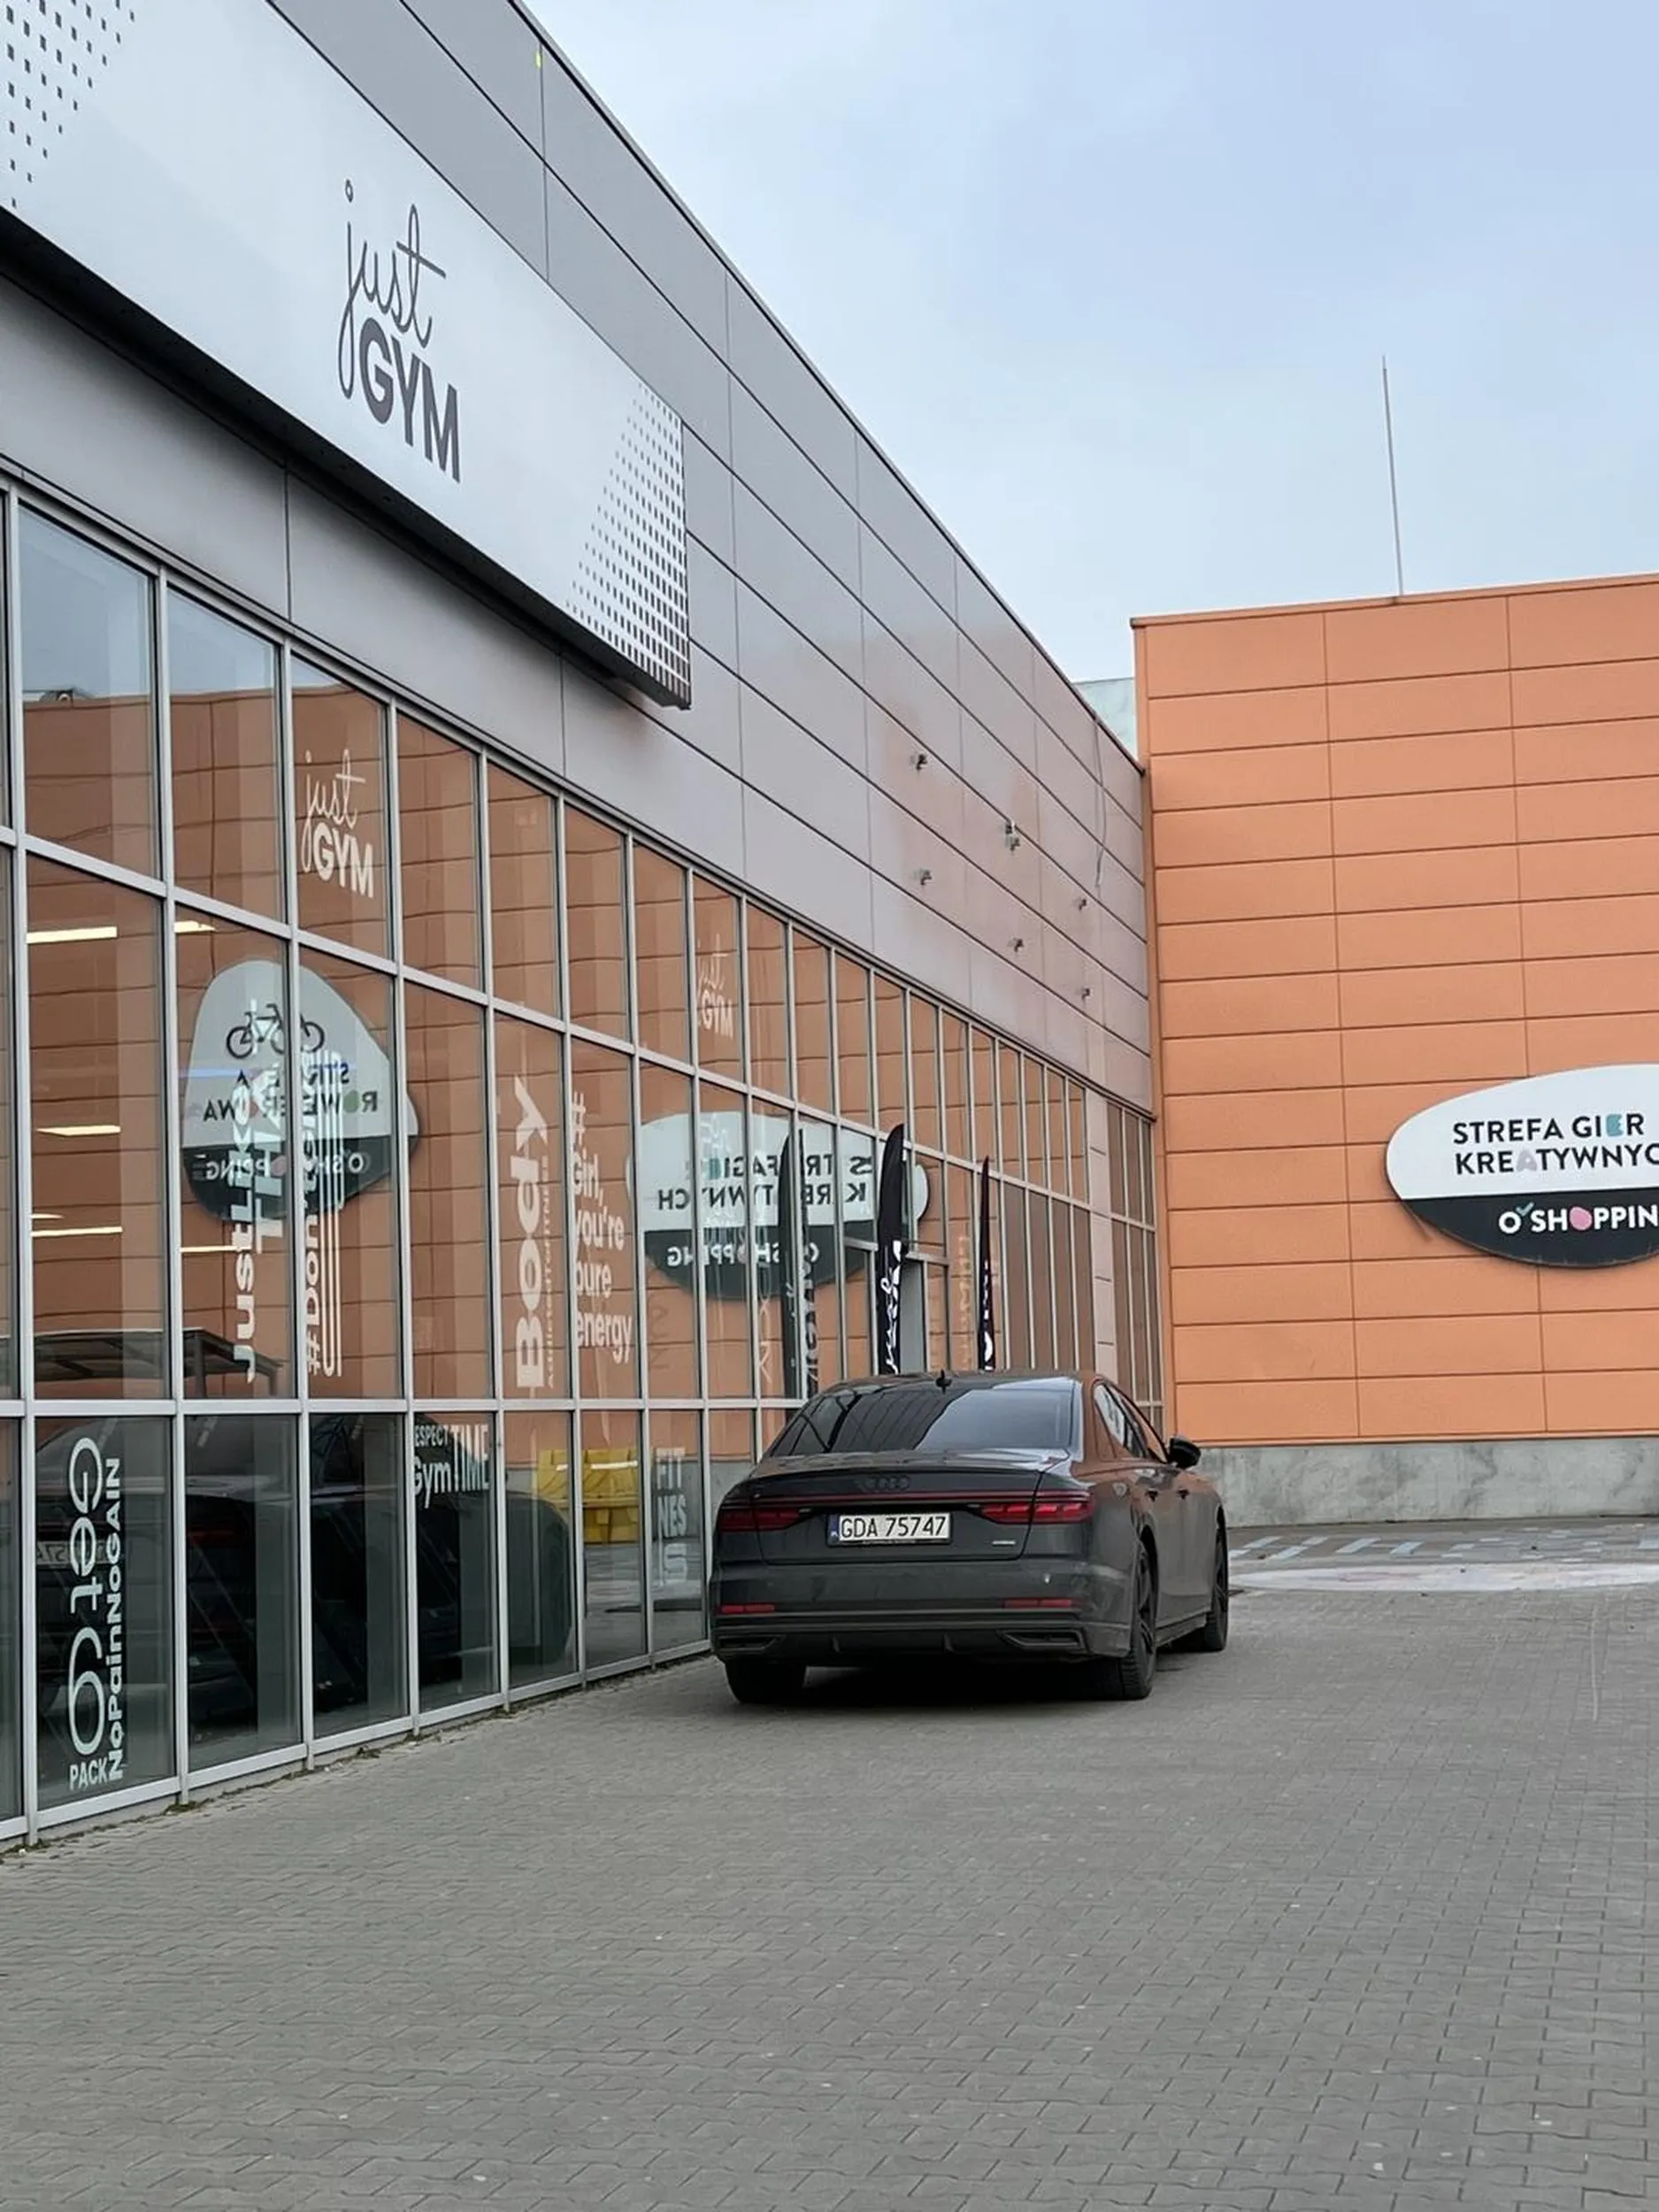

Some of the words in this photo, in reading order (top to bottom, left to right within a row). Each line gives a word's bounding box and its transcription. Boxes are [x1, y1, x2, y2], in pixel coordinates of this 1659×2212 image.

[338, 180, 446, 398] just
[359, 317, 460, 483] GYM
[301, 750, 366, 873] just
[312, 822, 373, 898] GYM
[702, 989, 733, 1041] GYM
[1453, 1118, 1563, 1145] STREFA
[1571, 1112, 1645, 1139] GIER
[576, 1311, 633, 1365] energy
[413, 1455, 451, 1509] Gym
[449, 1424, 490, 1493] TIME
[68, 1437, 103, 1615] Get
[841, 1517, 879, 1539] GDA
[885, 1515, 946, 1537] 75747
[68, 1626, 104, 1755] 6
[70, 1754, 109, 1791] PACK
